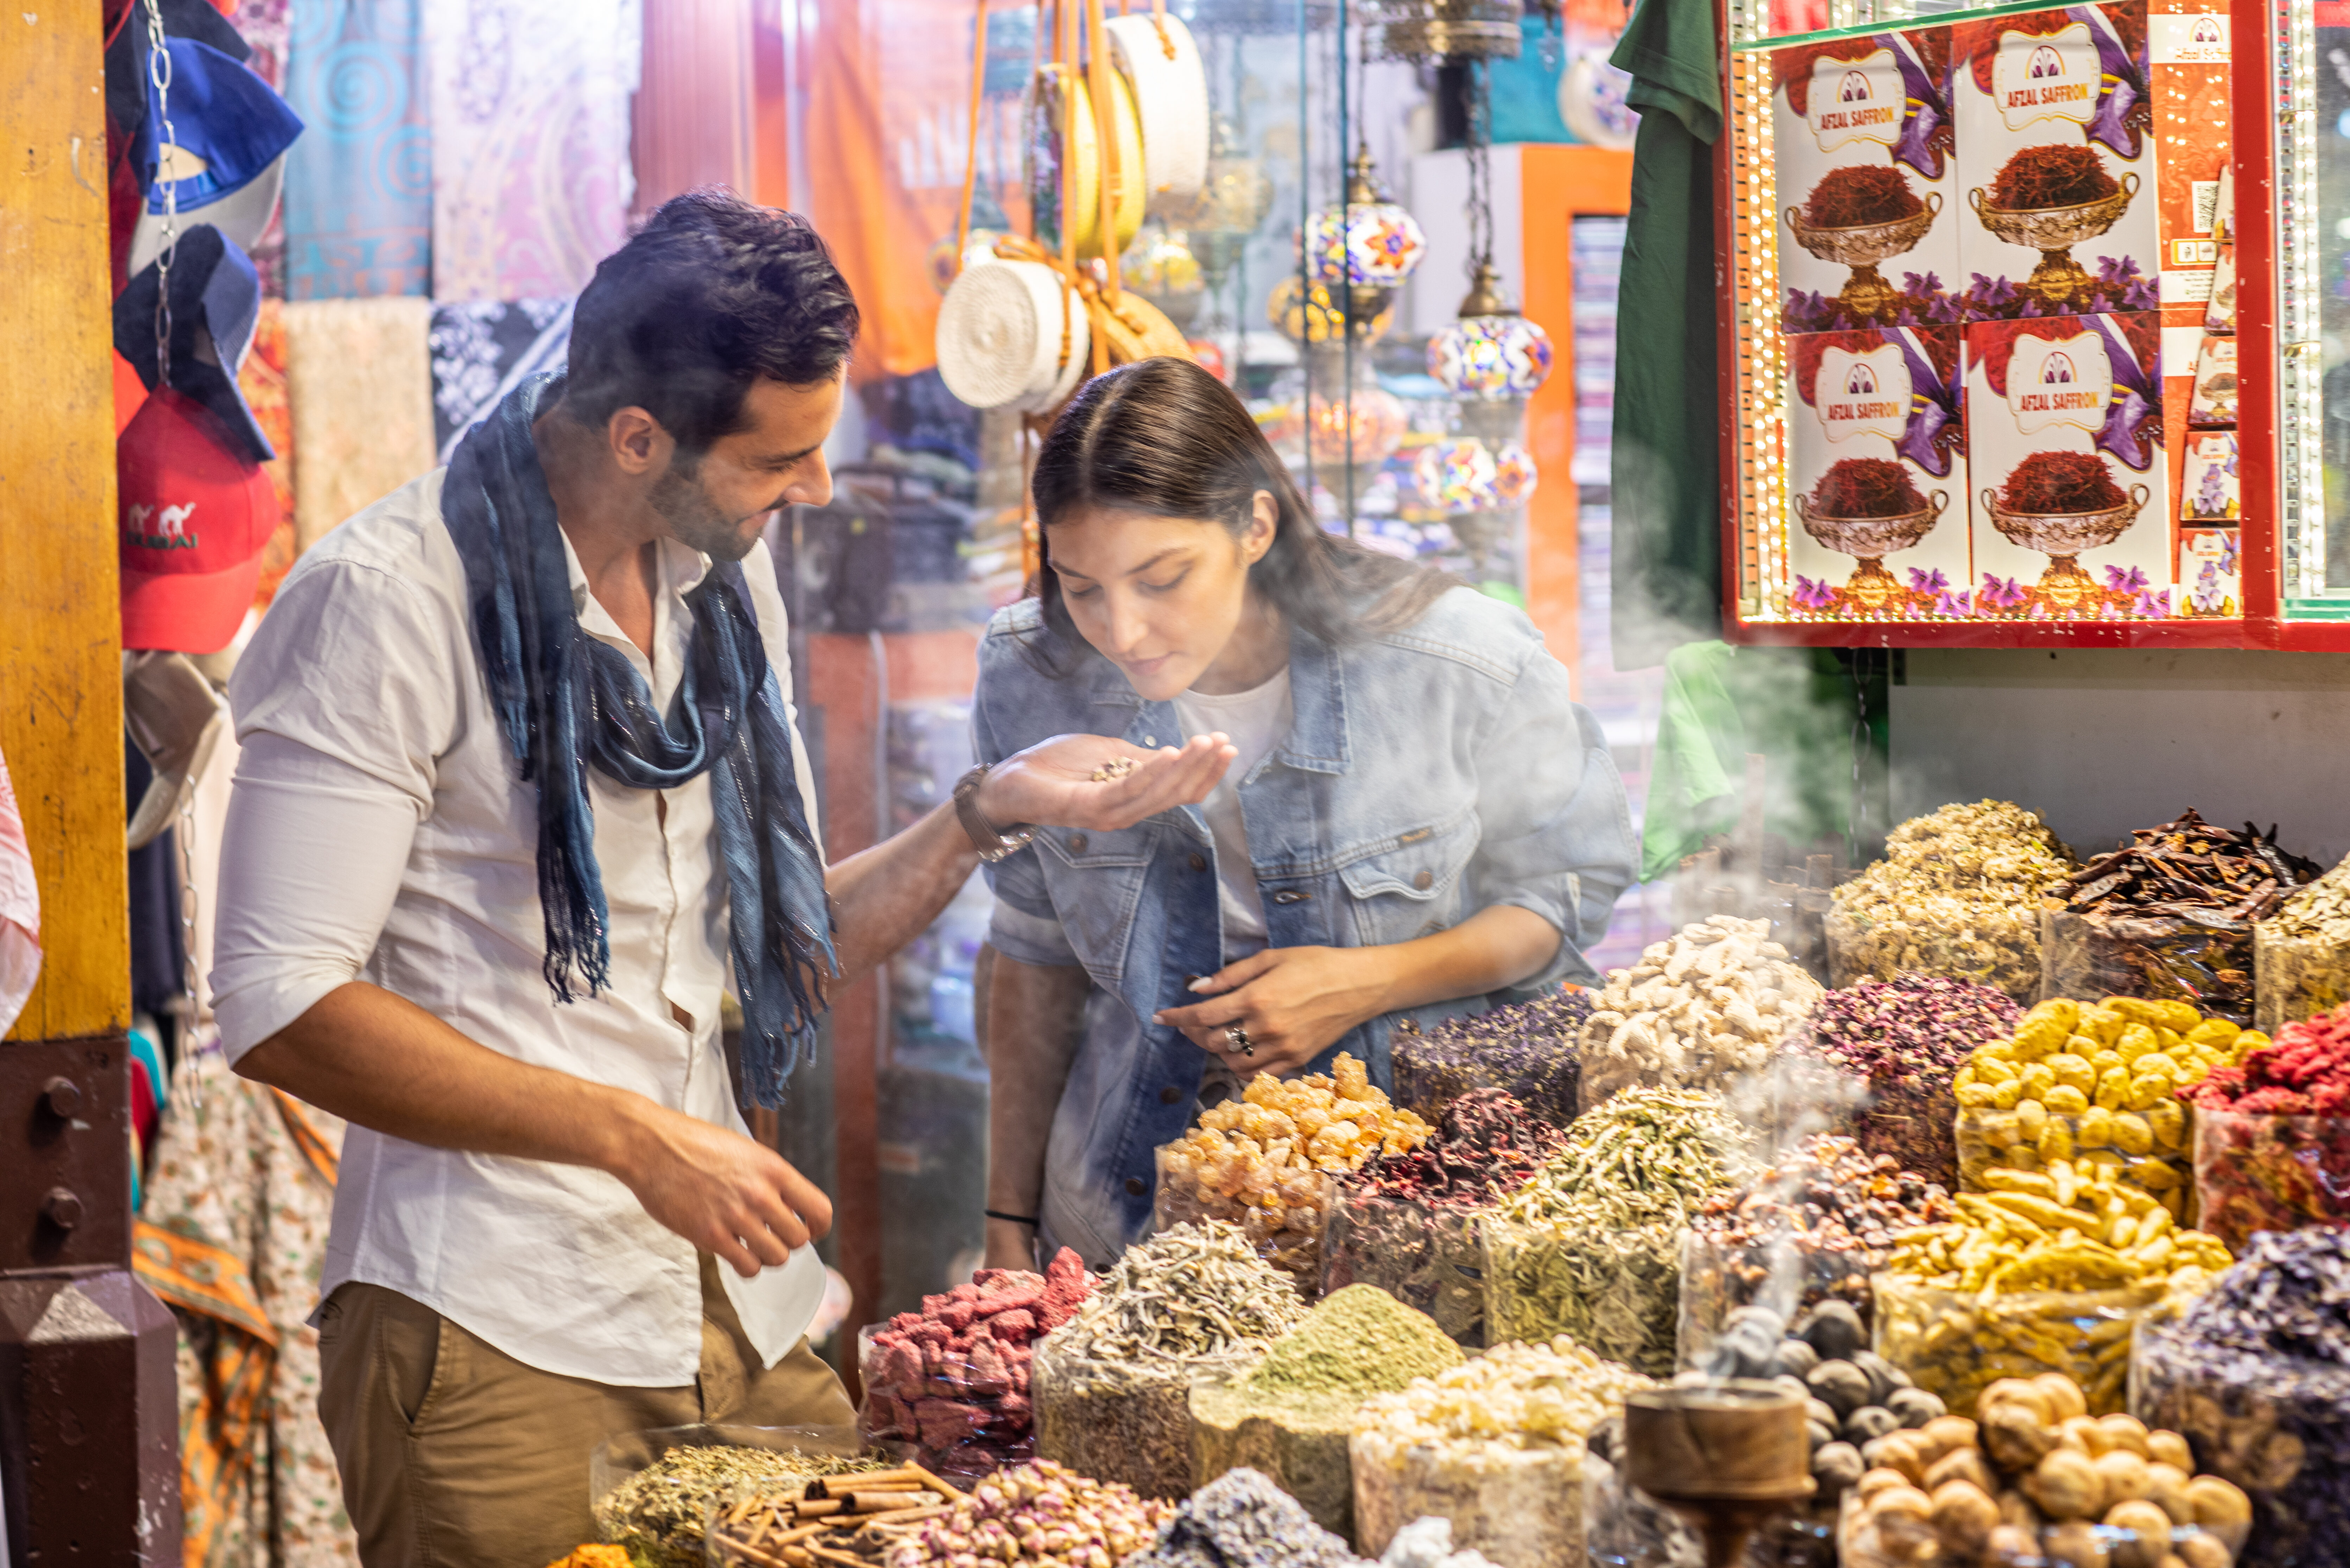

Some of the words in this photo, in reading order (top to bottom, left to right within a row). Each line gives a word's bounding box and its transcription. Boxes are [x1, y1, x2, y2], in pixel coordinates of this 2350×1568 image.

[2008, 89, 2038, 108] AFZAL
[2041, 83, 2089, 104] SAFFRON
[1821, 112, 1849, 130] AFZAL
[1851, 106, 1894, 127] SAFFRON
[1828, 404, 1854, 420] AFZAL
[1857, 402, 1900, 419] SAFFRON
[2021, 394, 2049, 411] AFZAL
[2053, 392, 2099, 410] SAFFRON
[126, 531, 197, 550] DUBAI
